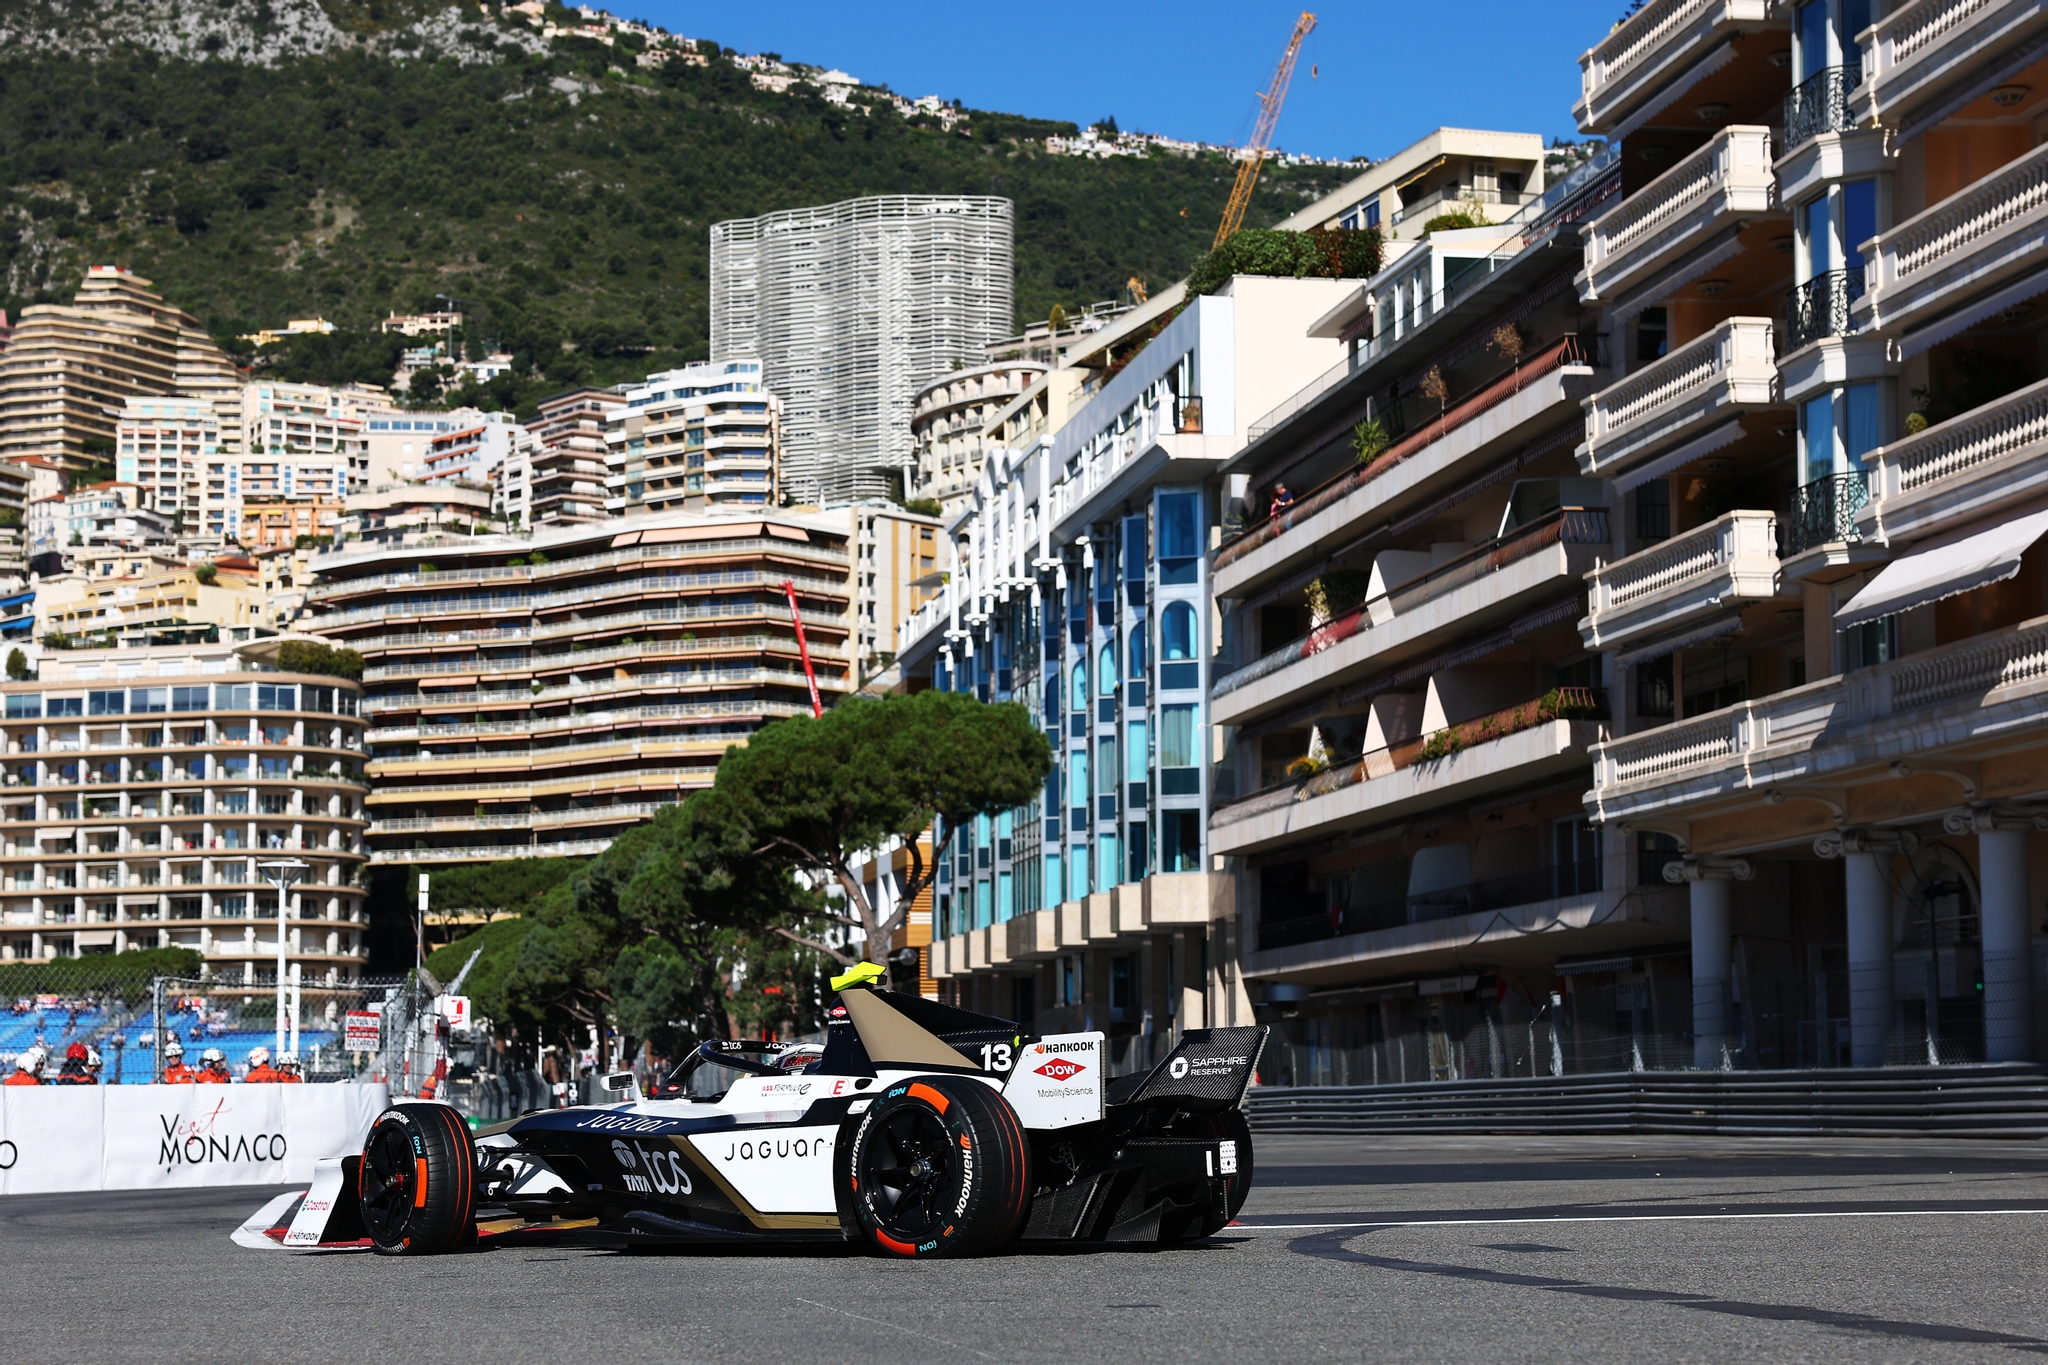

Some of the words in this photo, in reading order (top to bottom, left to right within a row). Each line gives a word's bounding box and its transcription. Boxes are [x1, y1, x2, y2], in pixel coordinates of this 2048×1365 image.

[980, 1043, 1012, 1072] 13
[1192, 1056, 1247, 1067] SAPPHIRE
[1037, 1087, 1094, 1098] MobilityScience
[160, 1096, 232, 1145] Visit
[159, 1134, 287, 1165] MONACO
[634, 1140, 693, 1195] tcs
[622, 1174, 653, 1193] TATA
[306, 1200, 331, 1211] Castrol
